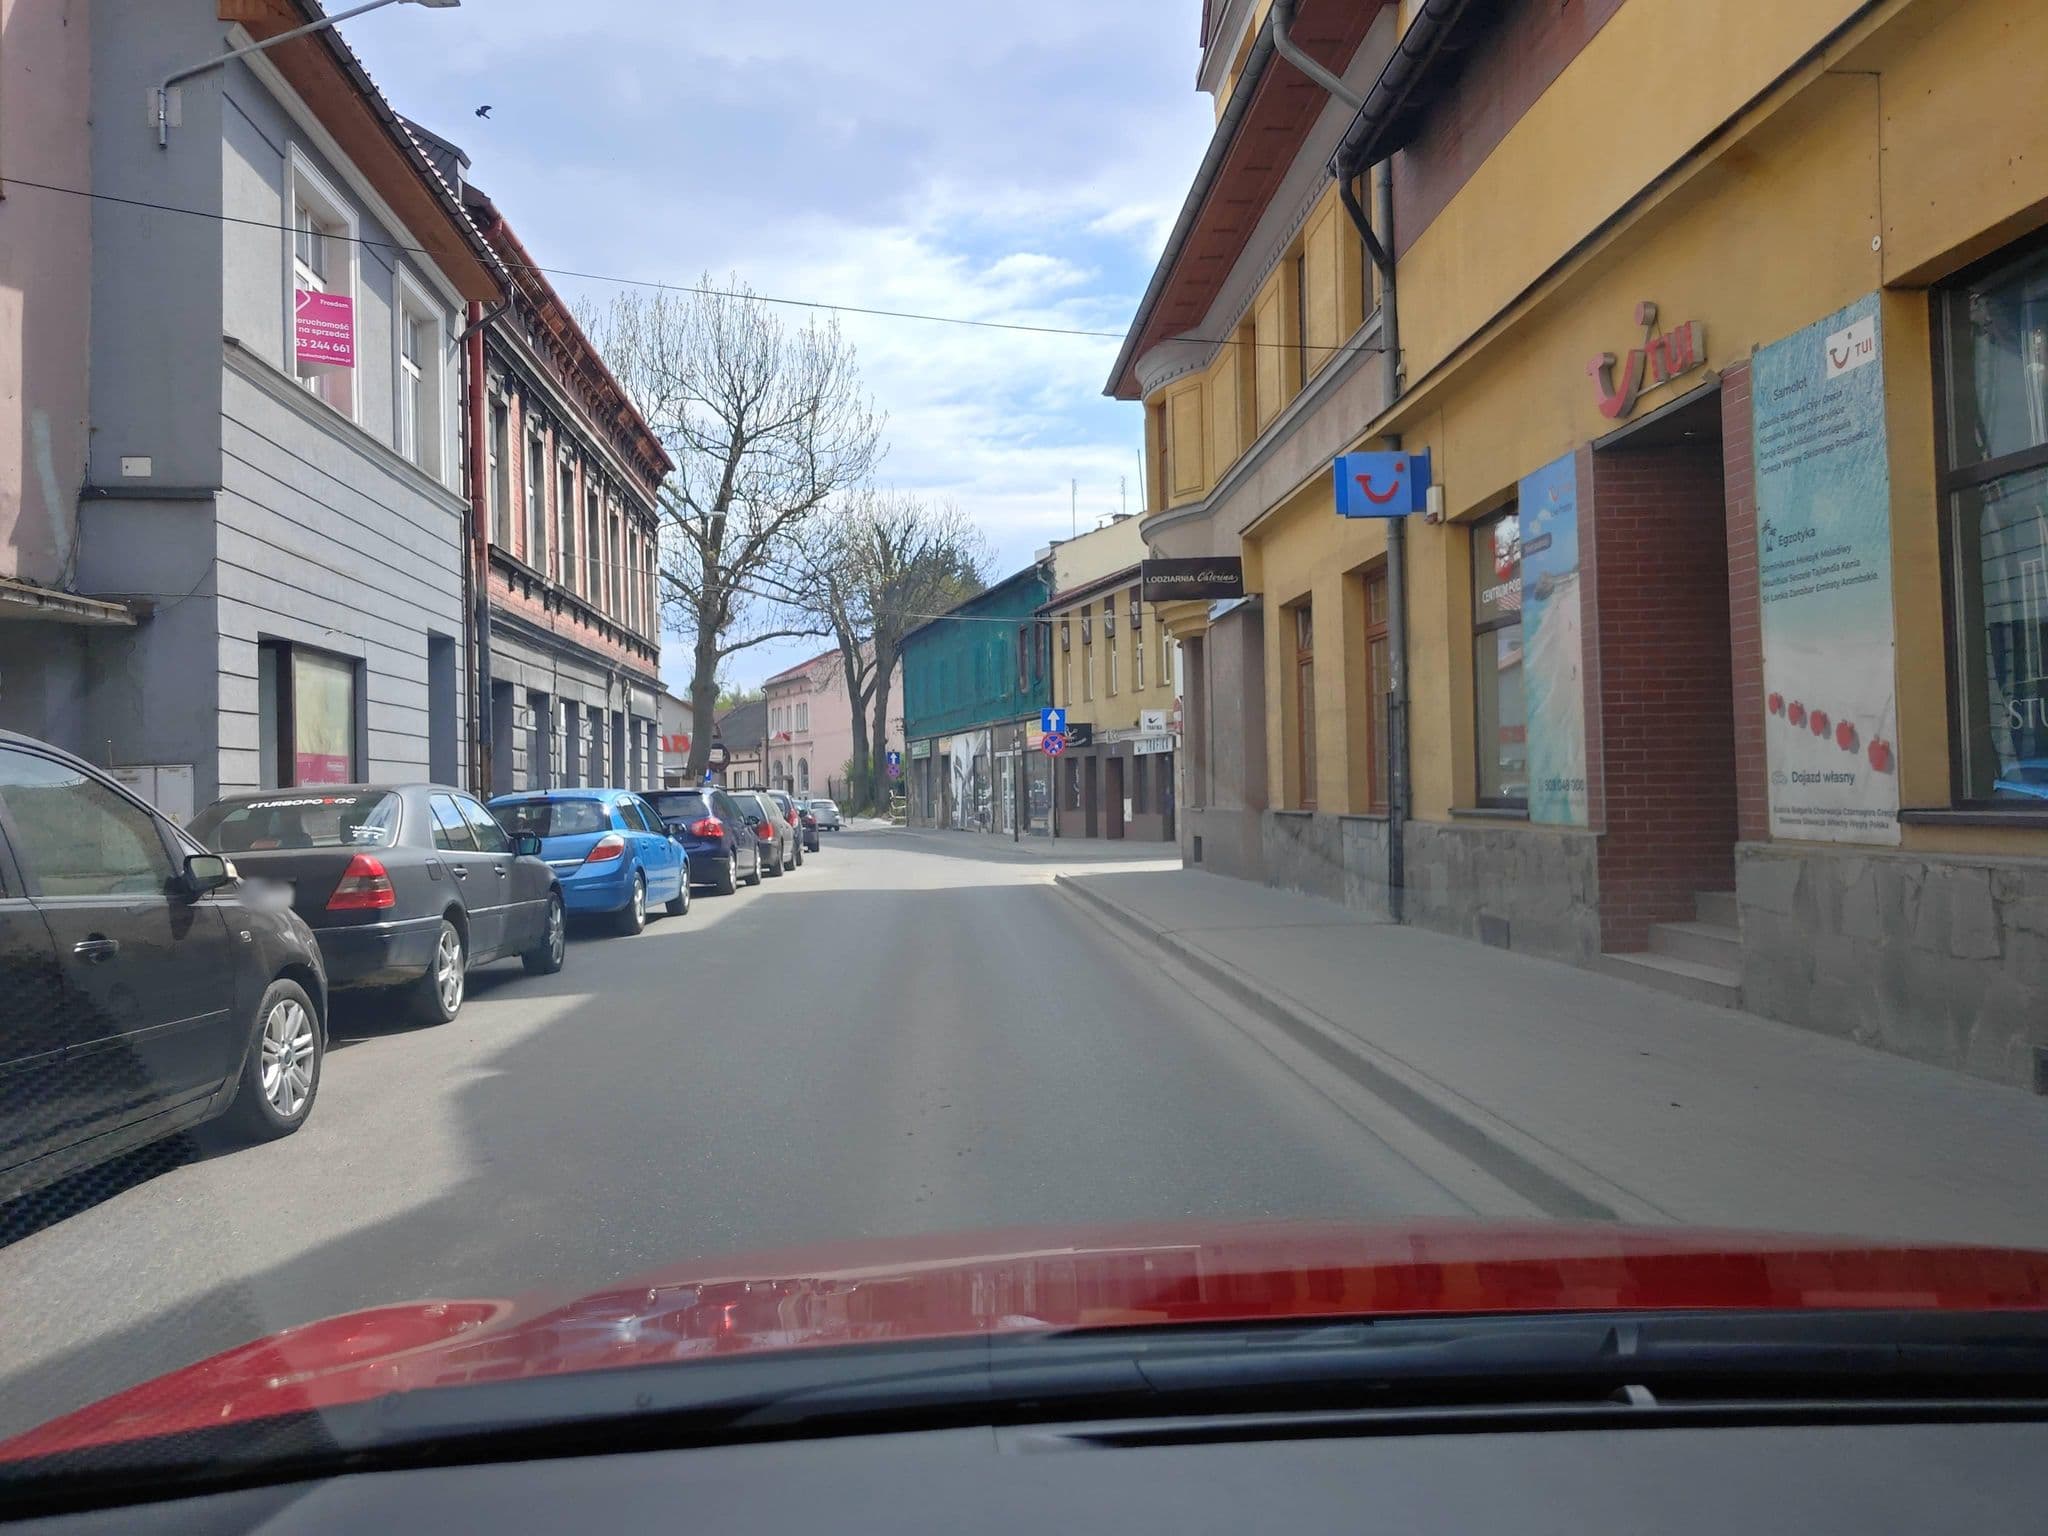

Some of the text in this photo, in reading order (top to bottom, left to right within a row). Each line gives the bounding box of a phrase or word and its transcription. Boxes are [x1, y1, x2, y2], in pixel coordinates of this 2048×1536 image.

[311, 329, 350, 339] sprzedaż
[310, 340, 330, 350] 244
[332, 343, 350, 353] 661
[1645, 320, 1703, 382] TUI
[1855, 337, 1872, 357] TUI
[1773, 378, 1807, 401] Samolot
[1778, 527, 1816, 547] Egzotyka
[1146, 575, 1195, 584] LODZIARNIA
[1792, 770, 1855, 786] Dojazd własny
